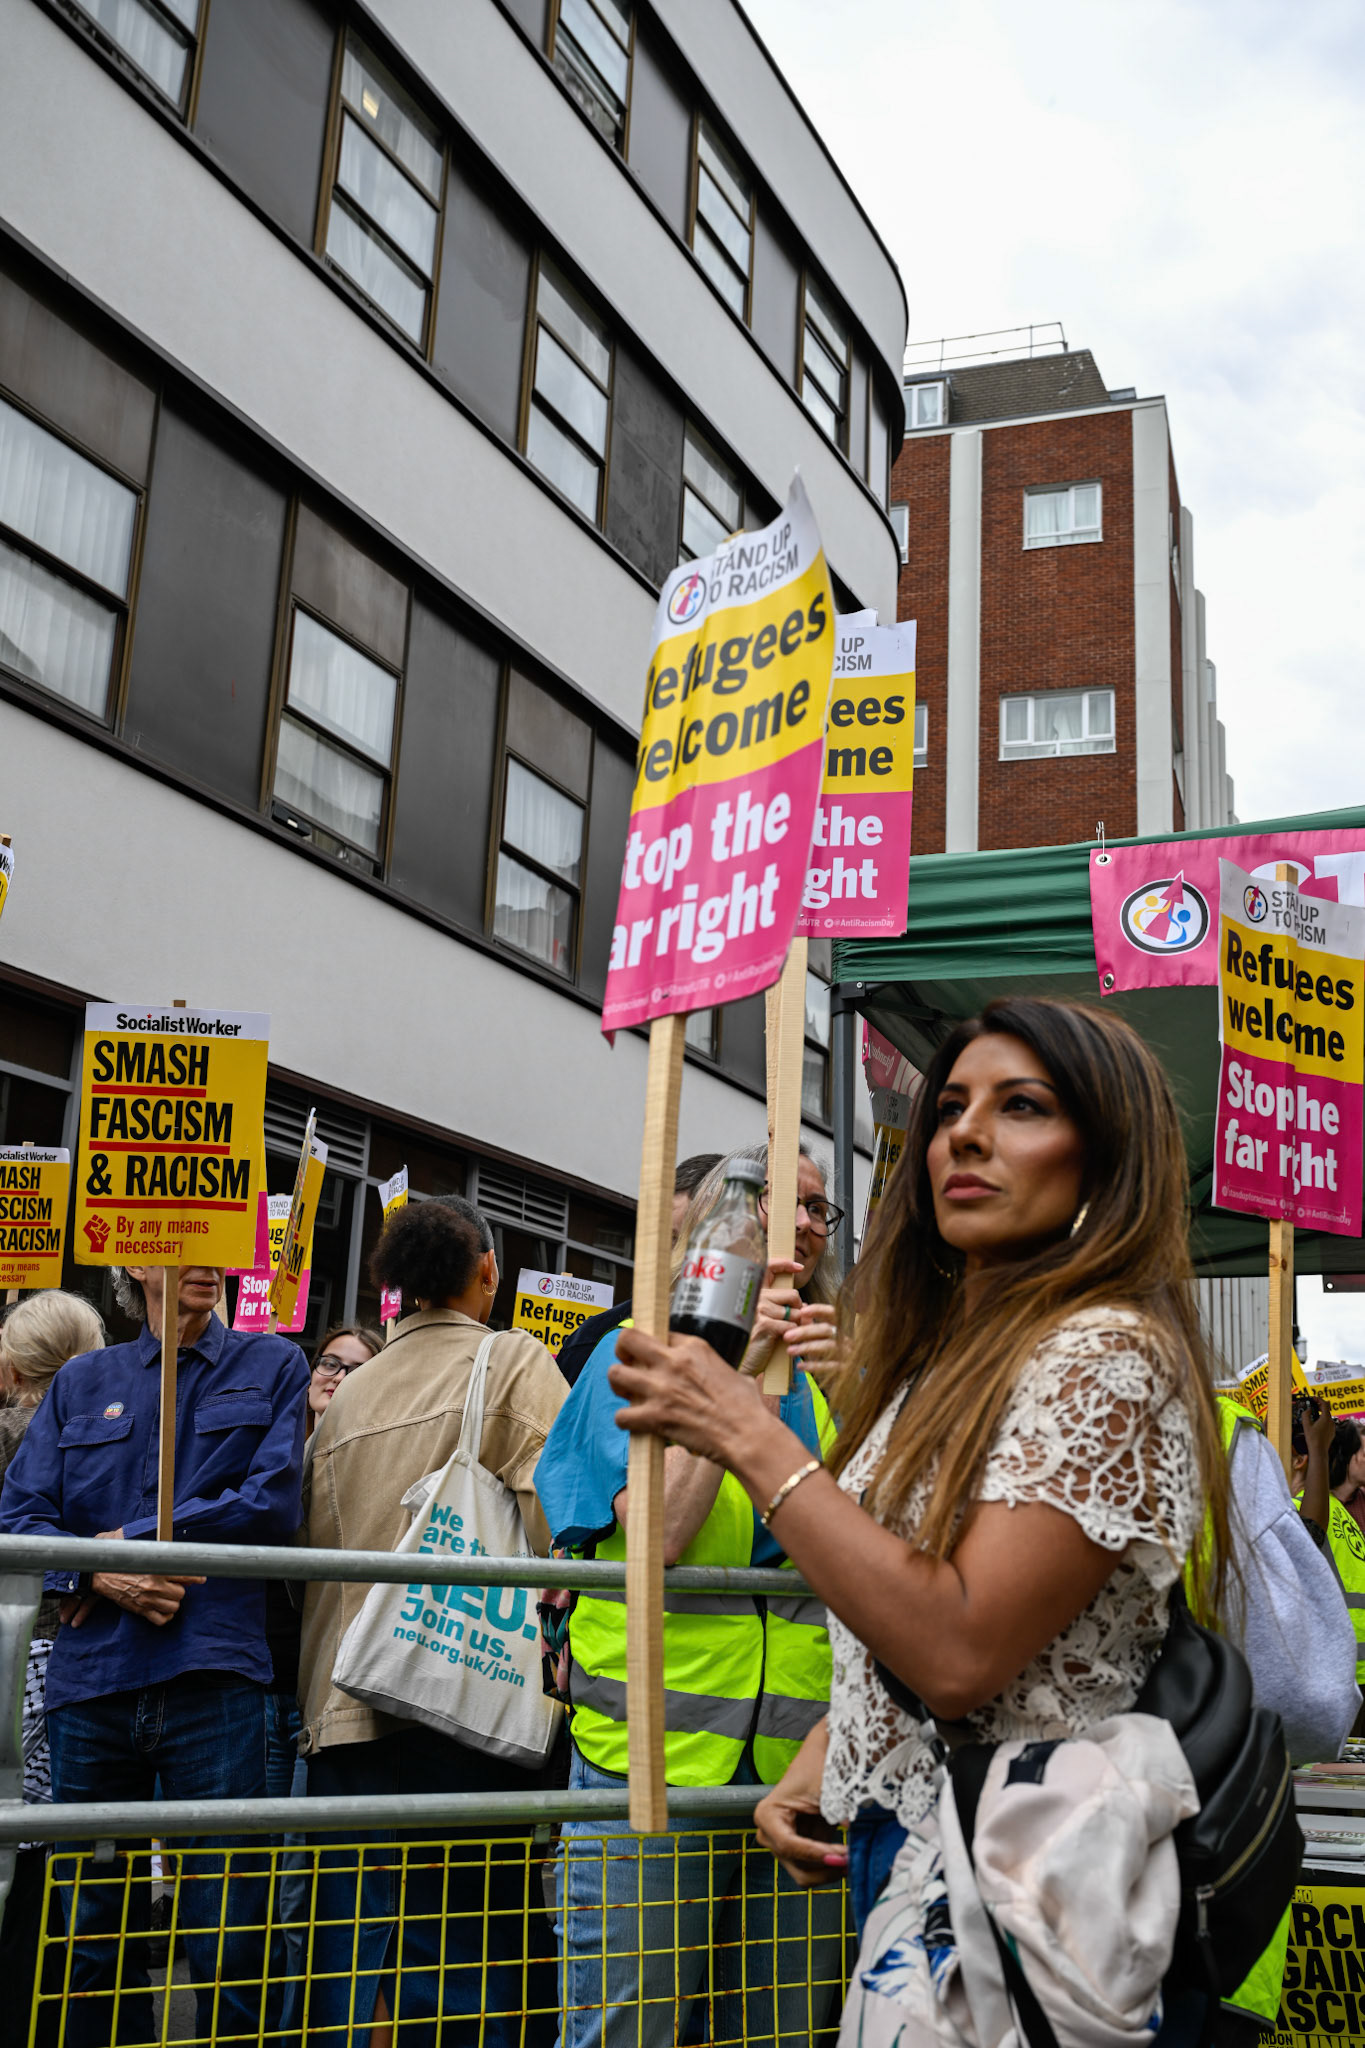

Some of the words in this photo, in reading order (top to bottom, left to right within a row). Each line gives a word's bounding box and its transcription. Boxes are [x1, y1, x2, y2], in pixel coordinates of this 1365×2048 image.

[711, 543, 767, 577] TAND
[773, 523, 792, 556] UP
[728, 544, 799, 597] RACISM
[842, 637, 865, 653] UP
[825, 695, 906, 728] ees
[812, 806, 883, 847] the
[623, 822, 693, 893] top
[711, 791, 791, 862] the
[656, 864, 780, 964] right
[1272, 910, 1291, 928] TO
[1300, 904, 1319, 923] UP
[1227, 928, 1355, 1011] Refuees
[186, 1017, 242, 1037] Worker
[1227, 995, 1345, 1063] welcme
[92, 1040, 210, 1086] SMASH
[1226, 1061, 1294, 1132] Stop
[1294, 1085, 1339, 1135] he
[89, 1097, 233, 1143] FASCISM
[30, 1152, 57, 1161] Worker
[1225, 1118, 1269, 1172] far
[86, 1153, 112, 1196] &
[126, 1155, 251, 1200] RACISM
[116, 1216, 135, 1236] By
[140, 1218, 163, 1236] any
[167, 1220, 209, 1235] means
[115, 1240, 184, 1258] necessary
[1, 1264, 15, 1274] any
[17, 1263, 40, 1271] means
[682, 1256, 725, 1282] oke
[242, 1276, 270, 1297] Stop
[555, 1280, 580, 1290] STAND
[581, 1284, 592, 1292] UP
[555, 1288, 565, 1297] TO
[567, 1290, 595, 1302] RACISM
[240, 1298, 258, 1316] far
[520, 1298, 591, 1329] Refuge
[430, 1502, 464, 1531] We
[423, 1526, 466, 1554] are
[401, 1597, 464, 1641] Join
[469, 1629, 513, 1662] us.
[393, 1626, 526, 1688] neu.org.uk/join
[1258, 2033, 1293, 2046] NDON
